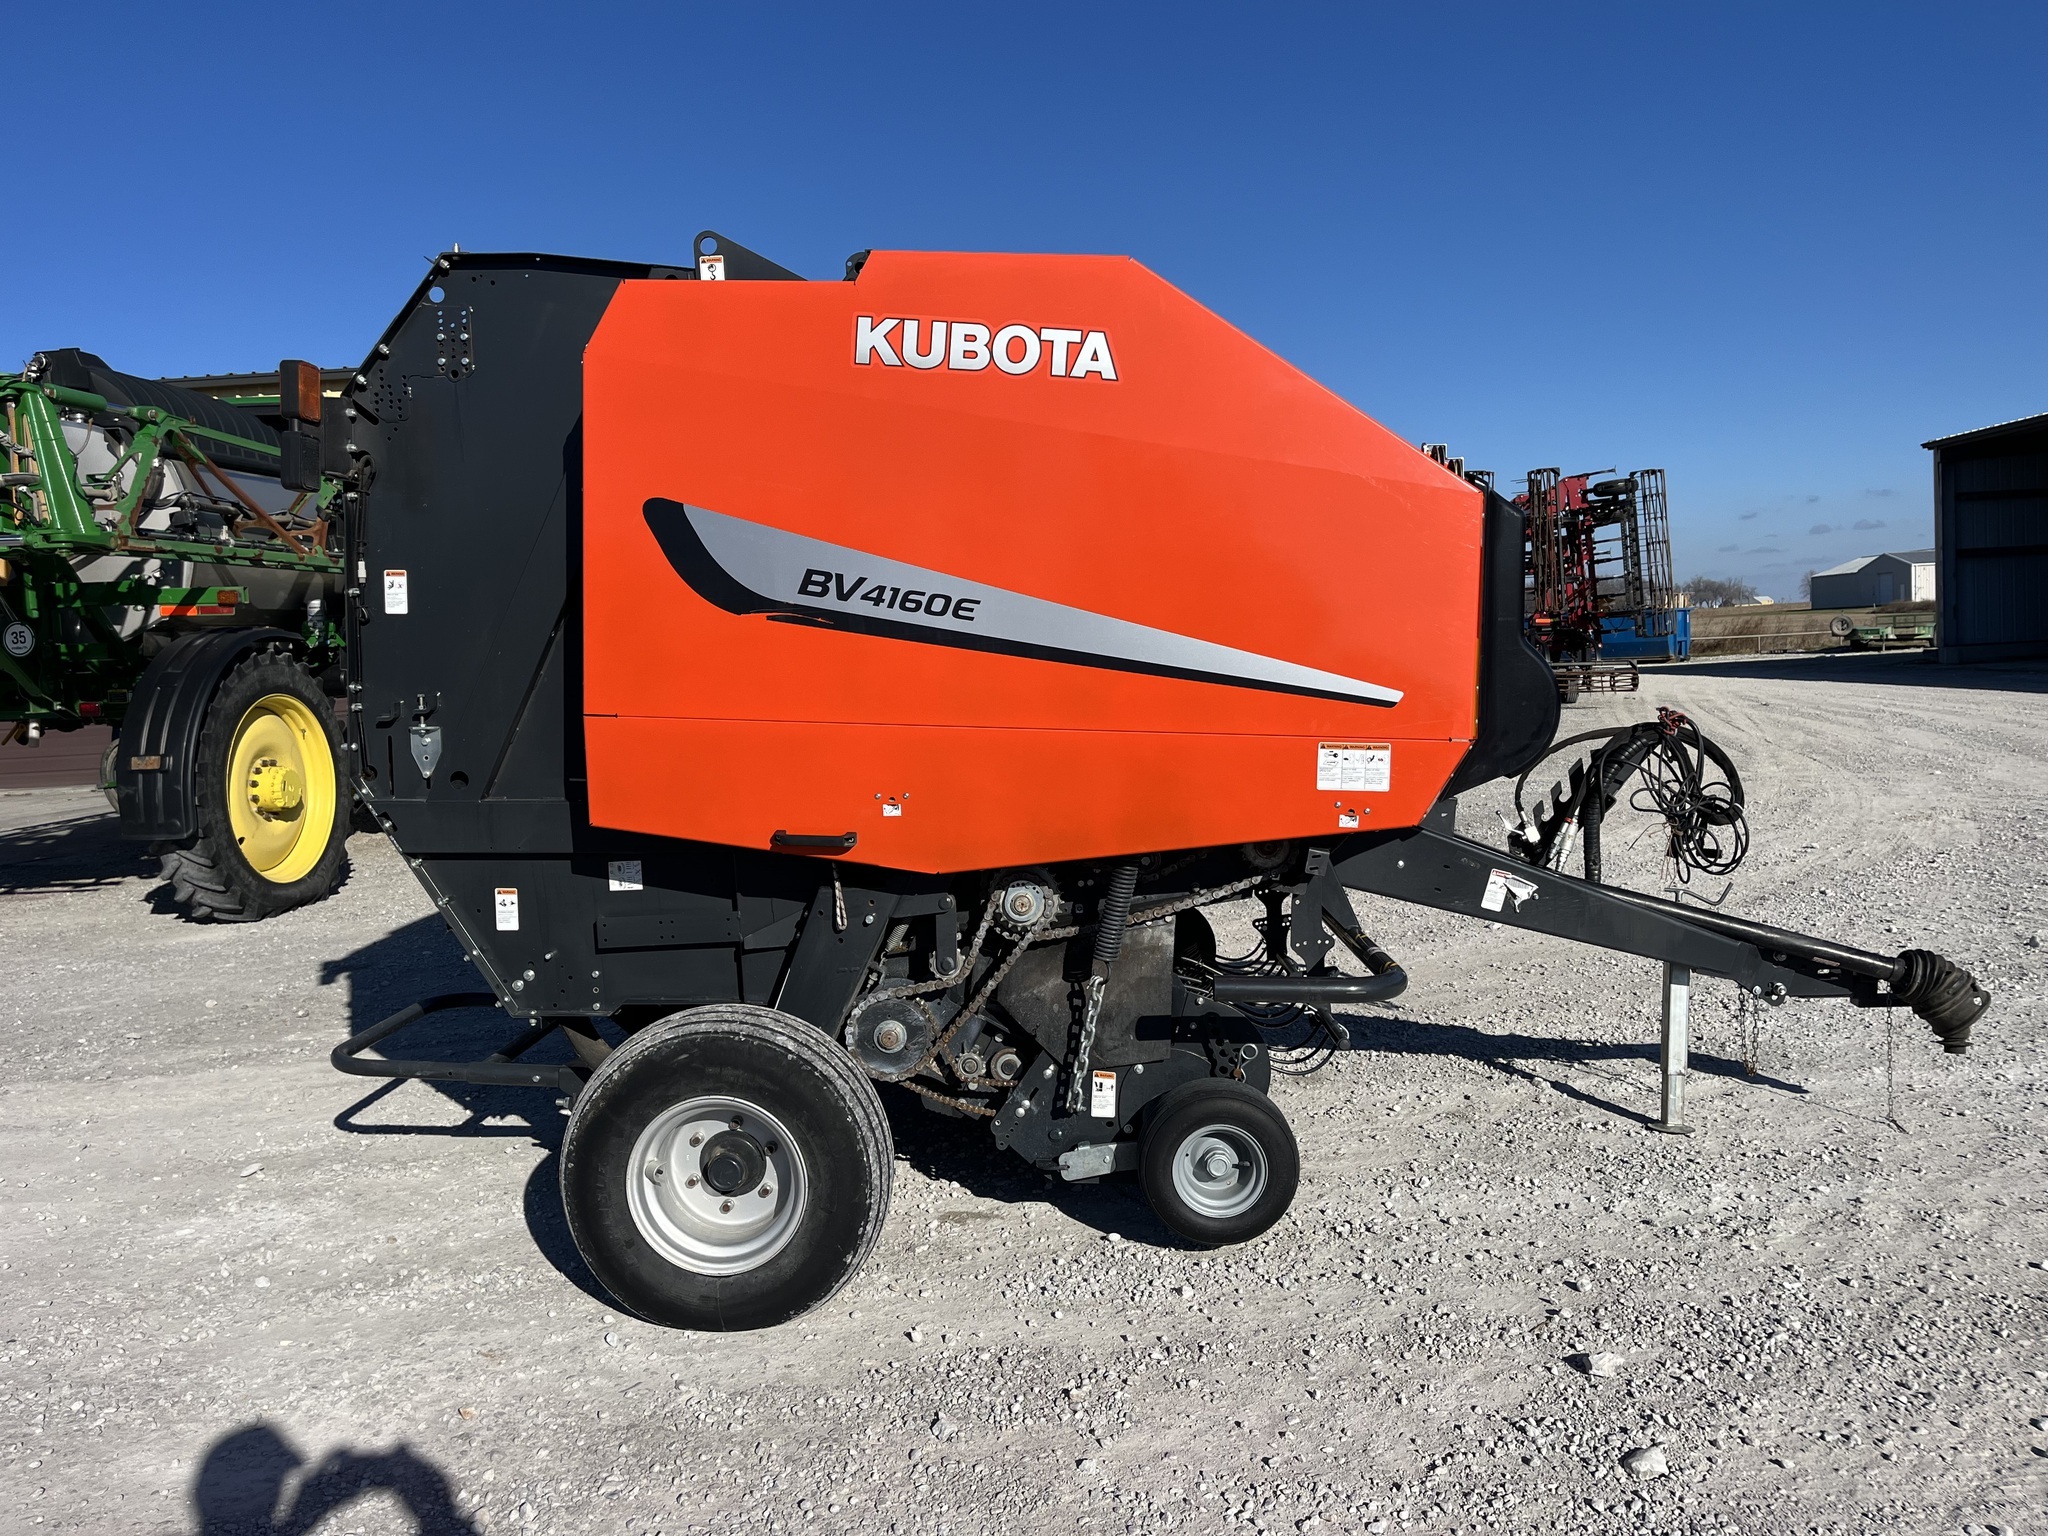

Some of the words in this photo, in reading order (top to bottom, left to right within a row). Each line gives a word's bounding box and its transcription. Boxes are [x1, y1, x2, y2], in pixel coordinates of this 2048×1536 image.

[854, 316, 1119, 381] KUBOTA
[797, 568, 981, 621] BV4160E
[11, 630, 27, 645] 35
